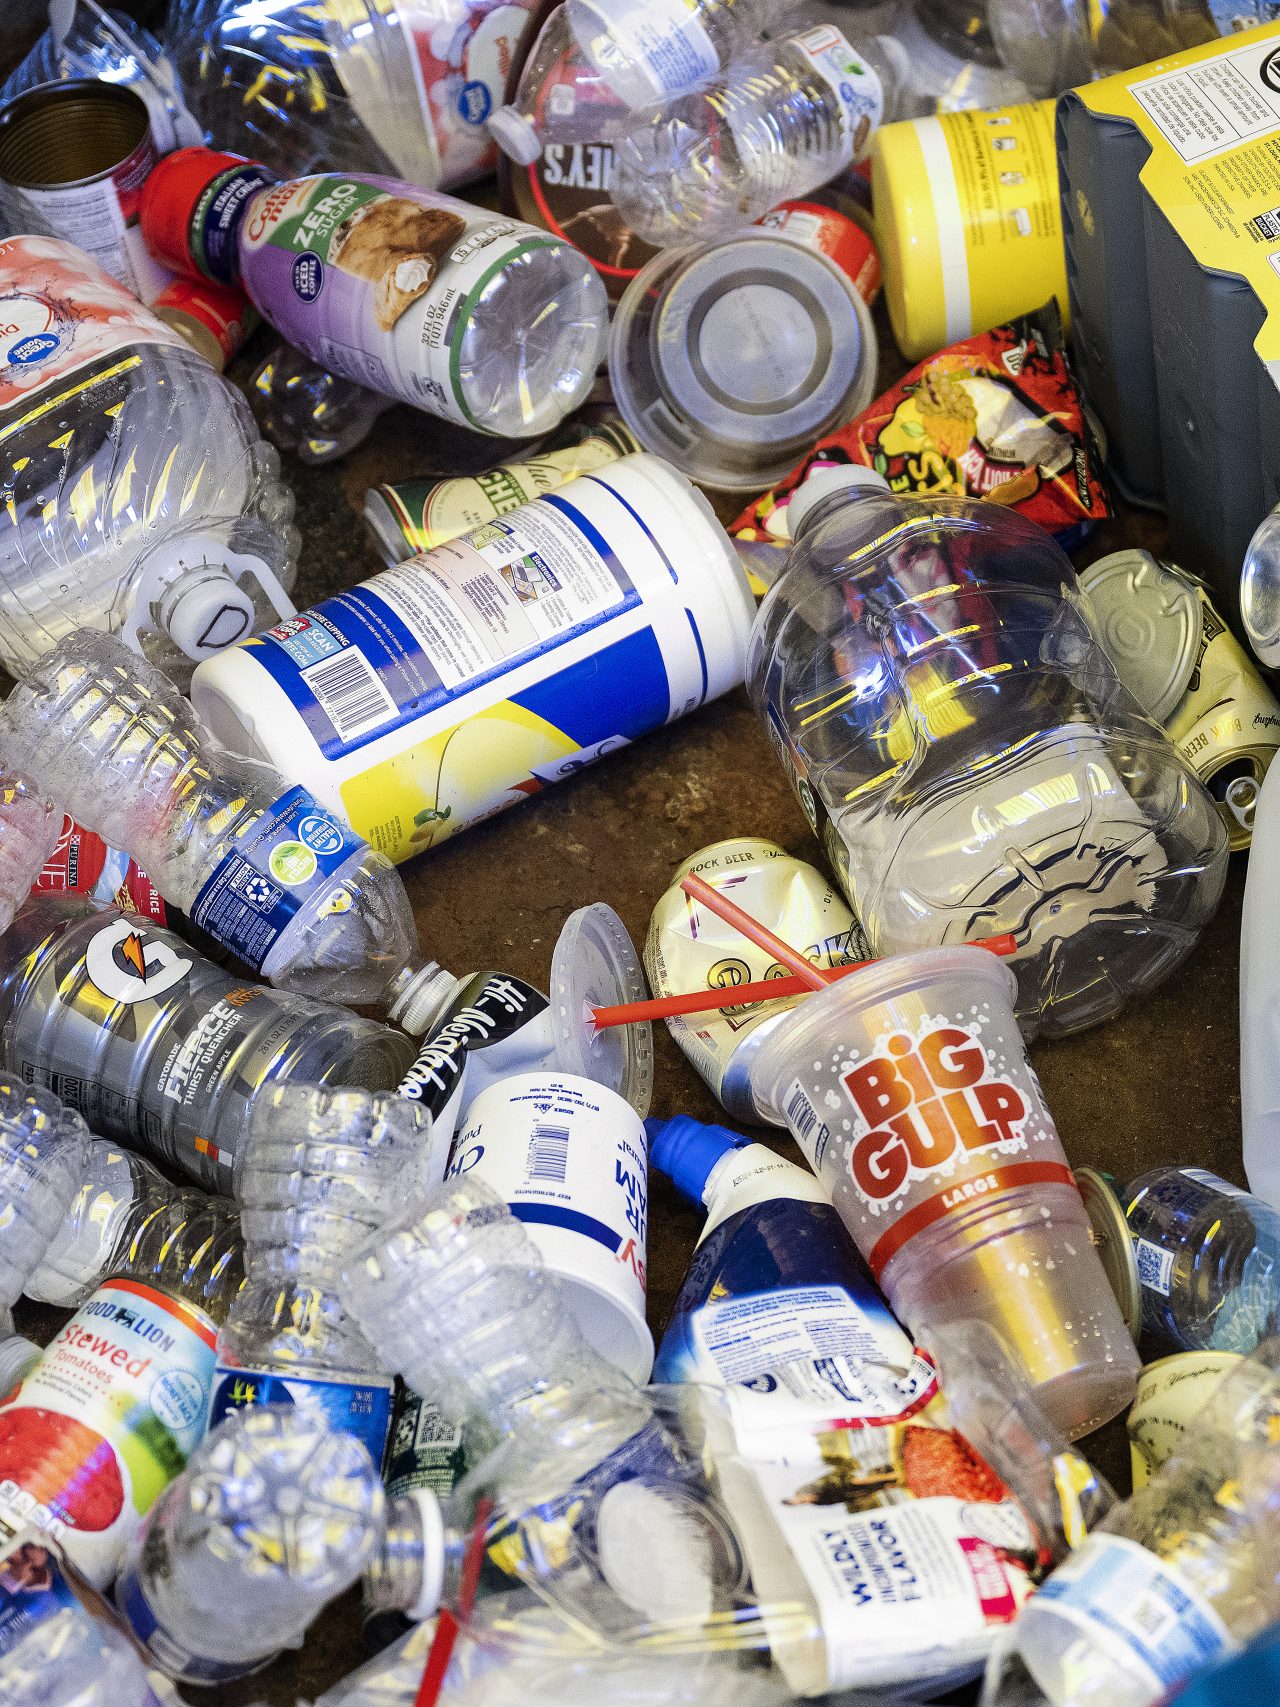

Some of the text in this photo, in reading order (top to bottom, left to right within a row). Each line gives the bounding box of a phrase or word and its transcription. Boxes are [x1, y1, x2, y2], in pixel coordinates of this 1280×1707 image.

[212, 175, 246, 213] ITALIAN
[216, 194, 240, 230] SWEET
[290, 177, 357, 251] ZERO
[314, 192, 357, 238] SUGAR
[1255, 217, 1272, 237] BUCKET
[1263, 214, 1279, 233] PLASTIC
[300, 262, 309, 293] ICED
[420, 303, 436, 345] 32 FL OZ
[430, 320, 443, 339] QT)
[10, 337, 41, 357] Value
[15, 336, 56, 362] Great
[531, 553, 558, 587] Electronics
[307, 626, 334, 652] SCAN
[311, 612, 350, 647] MORE CLIPPING
[311, 684, 338, 724] 19200 77182
[1182, 731, 1208, 759] BEER
[272, 820, 287, 837] more
[285, 809, 298, 824] Learn
[304, 821, 328, 843] HYDRATION
[311, 826, 335, 848] HEALTHY
[69, 845, 77, 884] PURINA
[223, 858, 241, 878] WARNING:
[231, 865, 249, 885] BOTTLE
[236, 868, 254, 890] PLASTIC
[287, 855, 311, 881] RECYCLE
[690, 852, 754, 873] BOCK BEER
[148, 888, 159, 914] RICE
[160, 999, 236, 1102] FIERCE
[182, 1011, 243, 1107] THIRST QUENCHER
[257, 1029, 282, 1055] 28 FL OZ
[155, 1042, 181, 1091] GATORADE
[204, 1048, 231, 1093] GREEN APPLE
[851, 1081, 1027, 1199] GULP
[941, 1172, 998, 1210] LARGE
[81, 1298, 176, 1353] FOOD LION
[53, 1347, 114, 1385] Tomatoes
[56, 1320, 152, 1381] Stewed
[823, 1529, 872, 1606] WILDLY
[869, 1519, 921, 1600] FLAVOR
